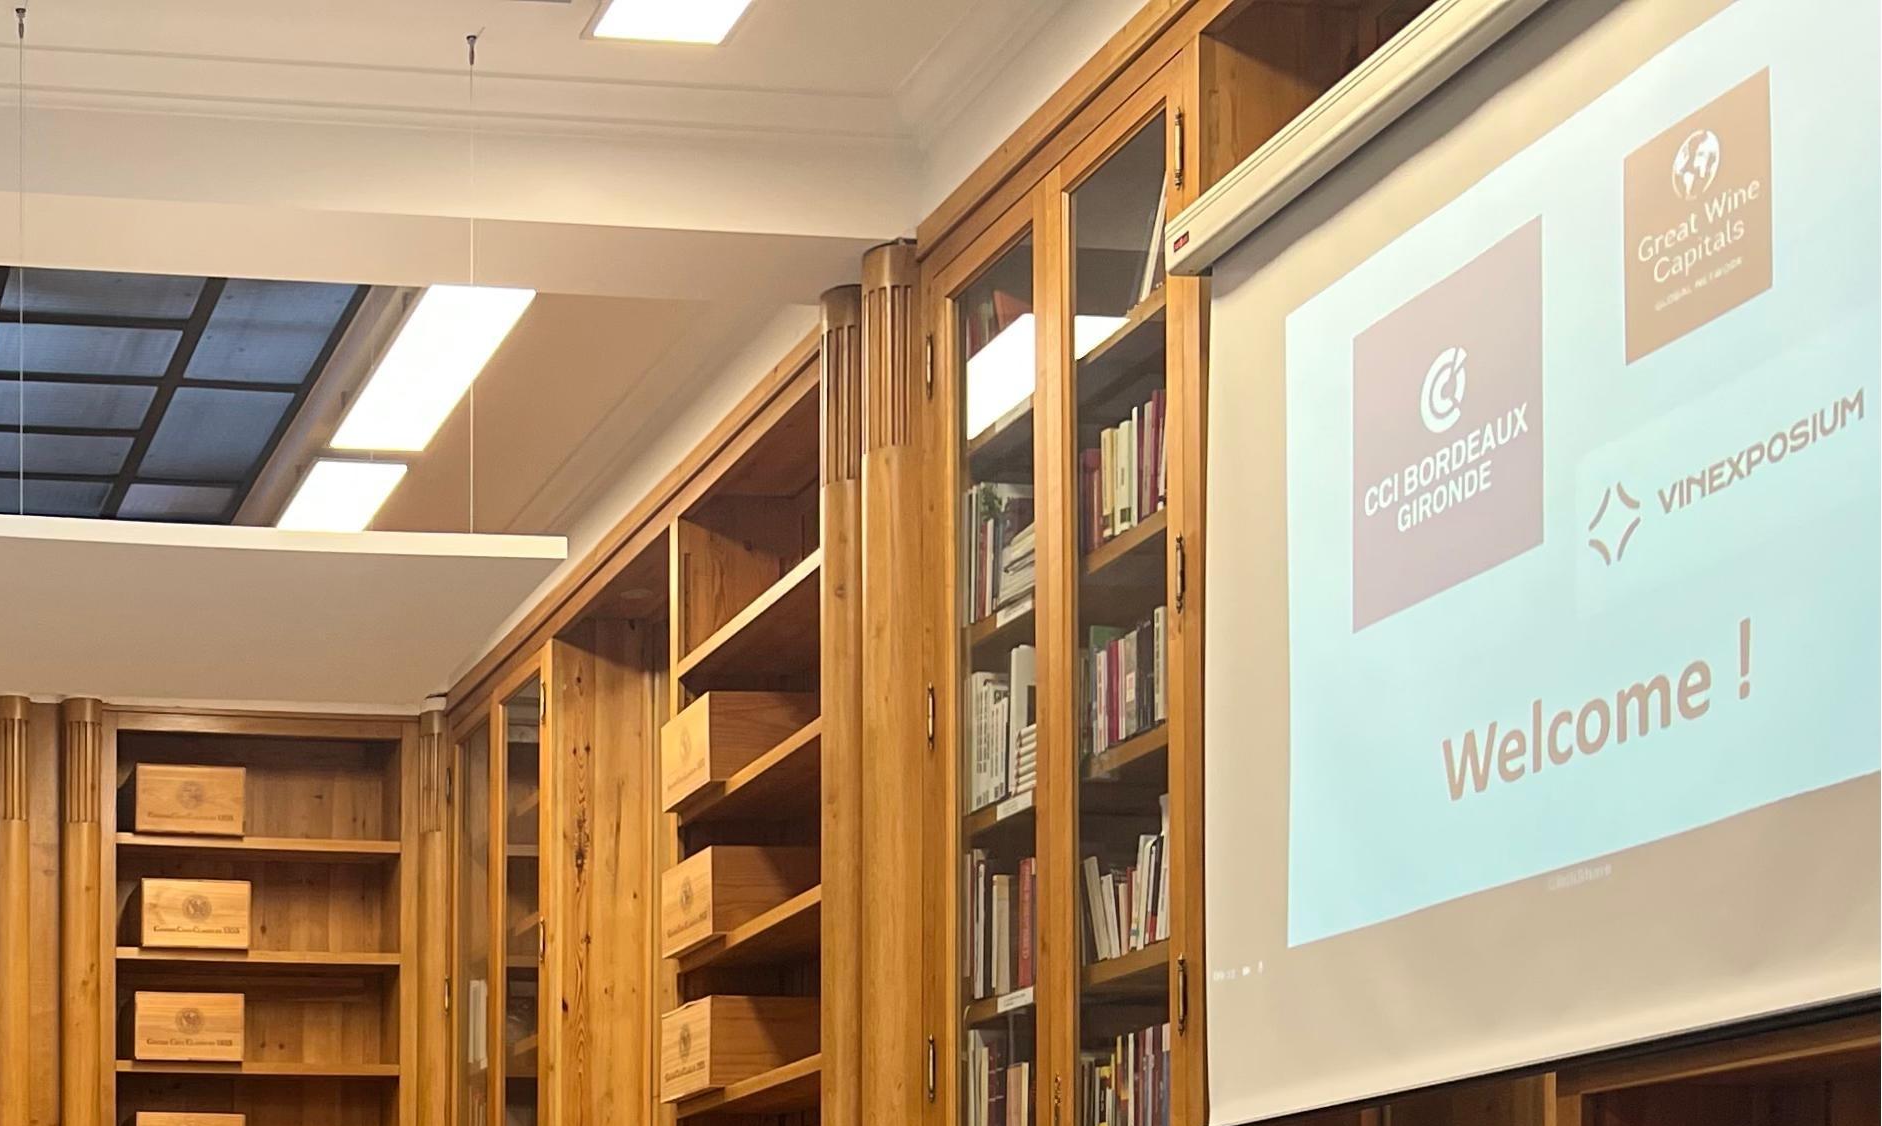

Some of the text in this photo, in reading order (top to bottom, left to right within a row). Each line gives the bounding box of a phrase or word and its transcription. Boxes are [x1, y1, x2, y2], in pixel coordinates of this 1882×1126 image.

[1638, 179, 1760, 262] Great Wine
[1653, 219, 1745, 283] Capitals
[1364, 401, 1528, 517] CCI BORDEAUX
[1397, 460, 1492, 532] GIRONDE
[1658, 387, 1864, 515] VINEXPOSIUM
[1442, 660, 1712, 801] Welcome
